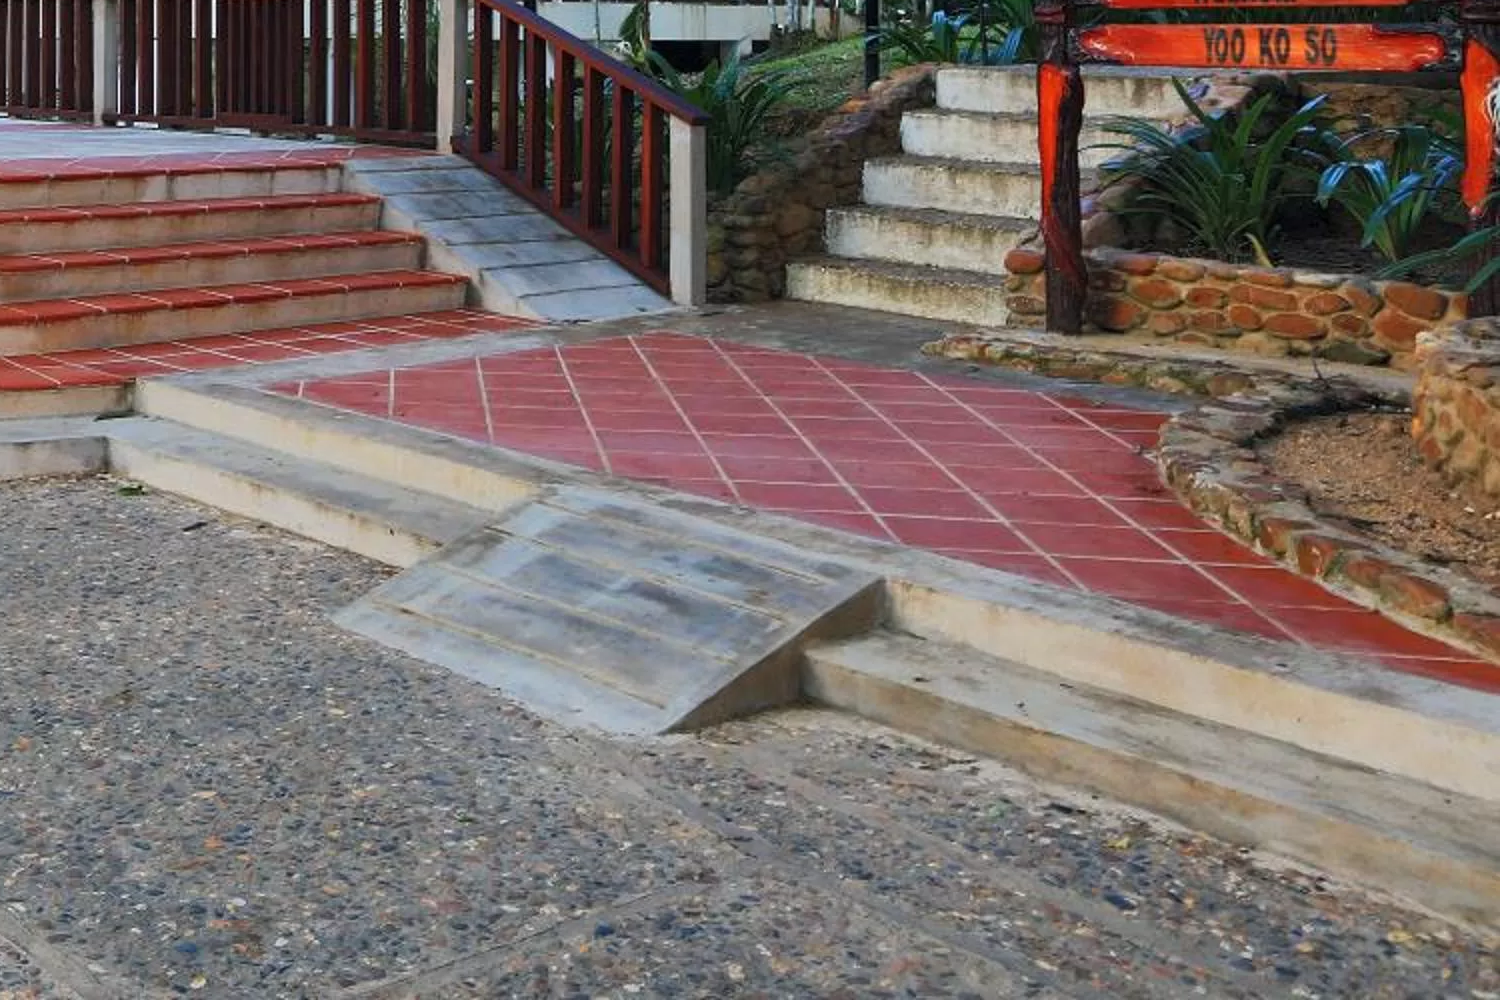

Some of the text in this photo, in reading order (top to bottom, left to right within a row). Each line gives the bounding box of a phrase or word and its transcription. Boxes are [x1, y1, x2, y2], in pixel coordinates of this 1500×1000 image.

[1204, 26, 1337, 65] YOO KO SO
